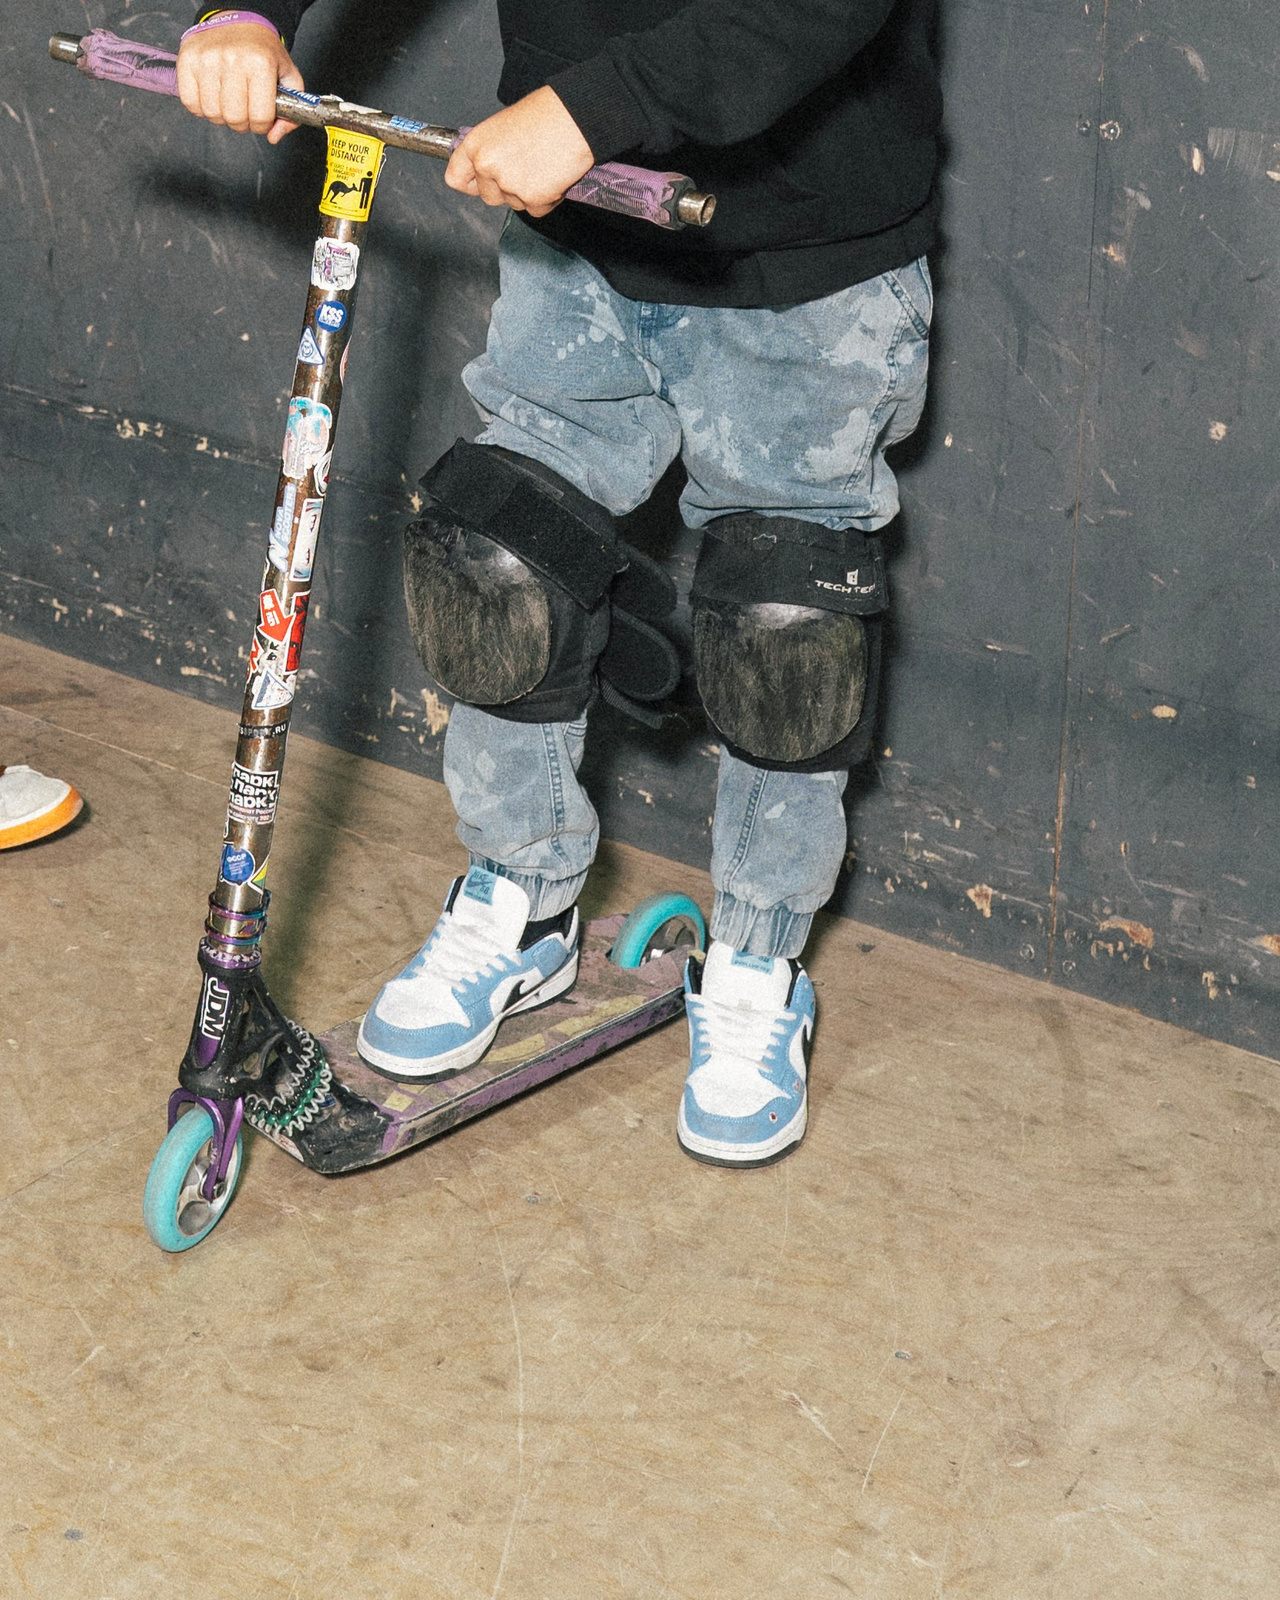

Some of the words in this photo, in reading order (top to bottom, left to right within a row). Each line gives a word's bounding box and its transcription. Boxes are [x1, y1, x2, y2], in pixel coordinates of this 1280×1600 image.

[331, 138, 346, 150] KEEP
[348, 142, 370, 155] YOUR
[330, 148, 366, 164] DISTANCE
[814, 579, 852, 594] TECH
[201, 977, 230, 1041] JDM
